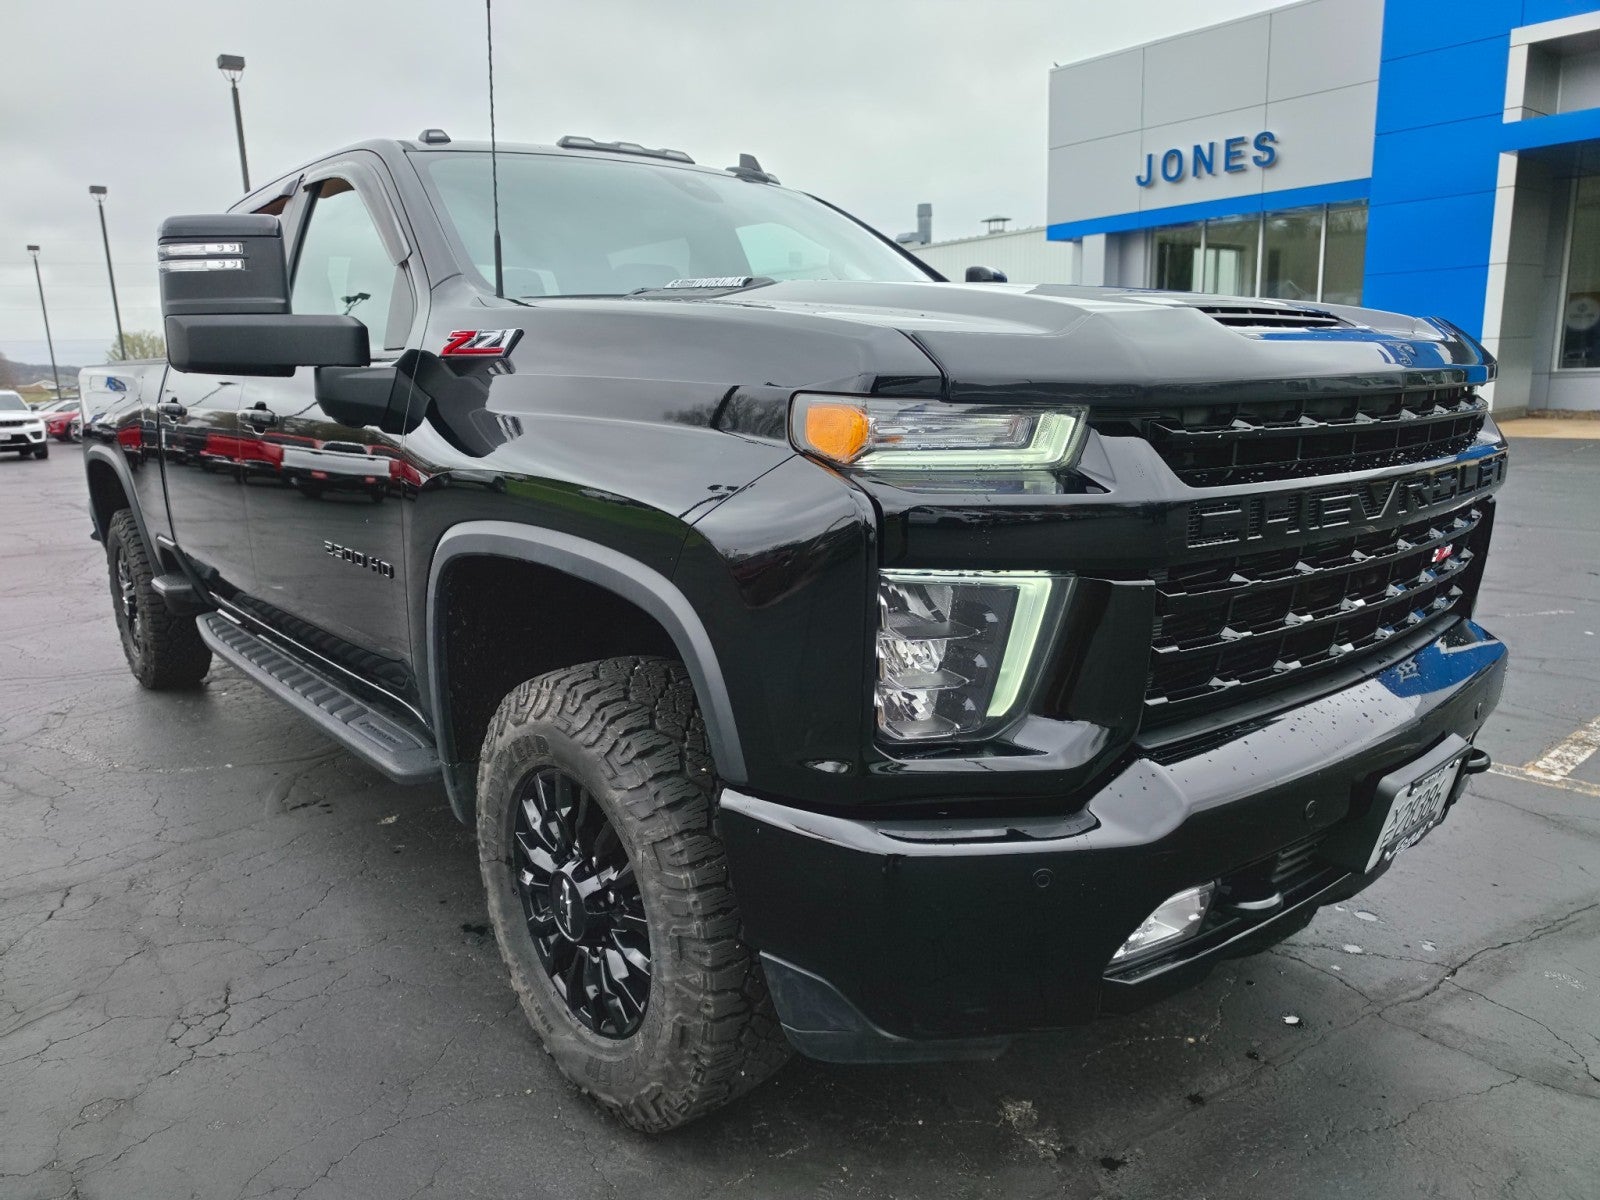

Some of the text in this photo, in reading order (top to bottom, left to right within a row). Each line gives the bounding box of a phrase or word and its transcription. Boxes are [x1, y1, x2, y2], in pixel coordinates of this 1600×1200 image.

[1135, 131, 1278, 187] JONES
[440, 328, 523, 359] Z71
[1187, 451, 1507, 548] CHEVROLET
[323, 540, 394, 579] 2500 HD
